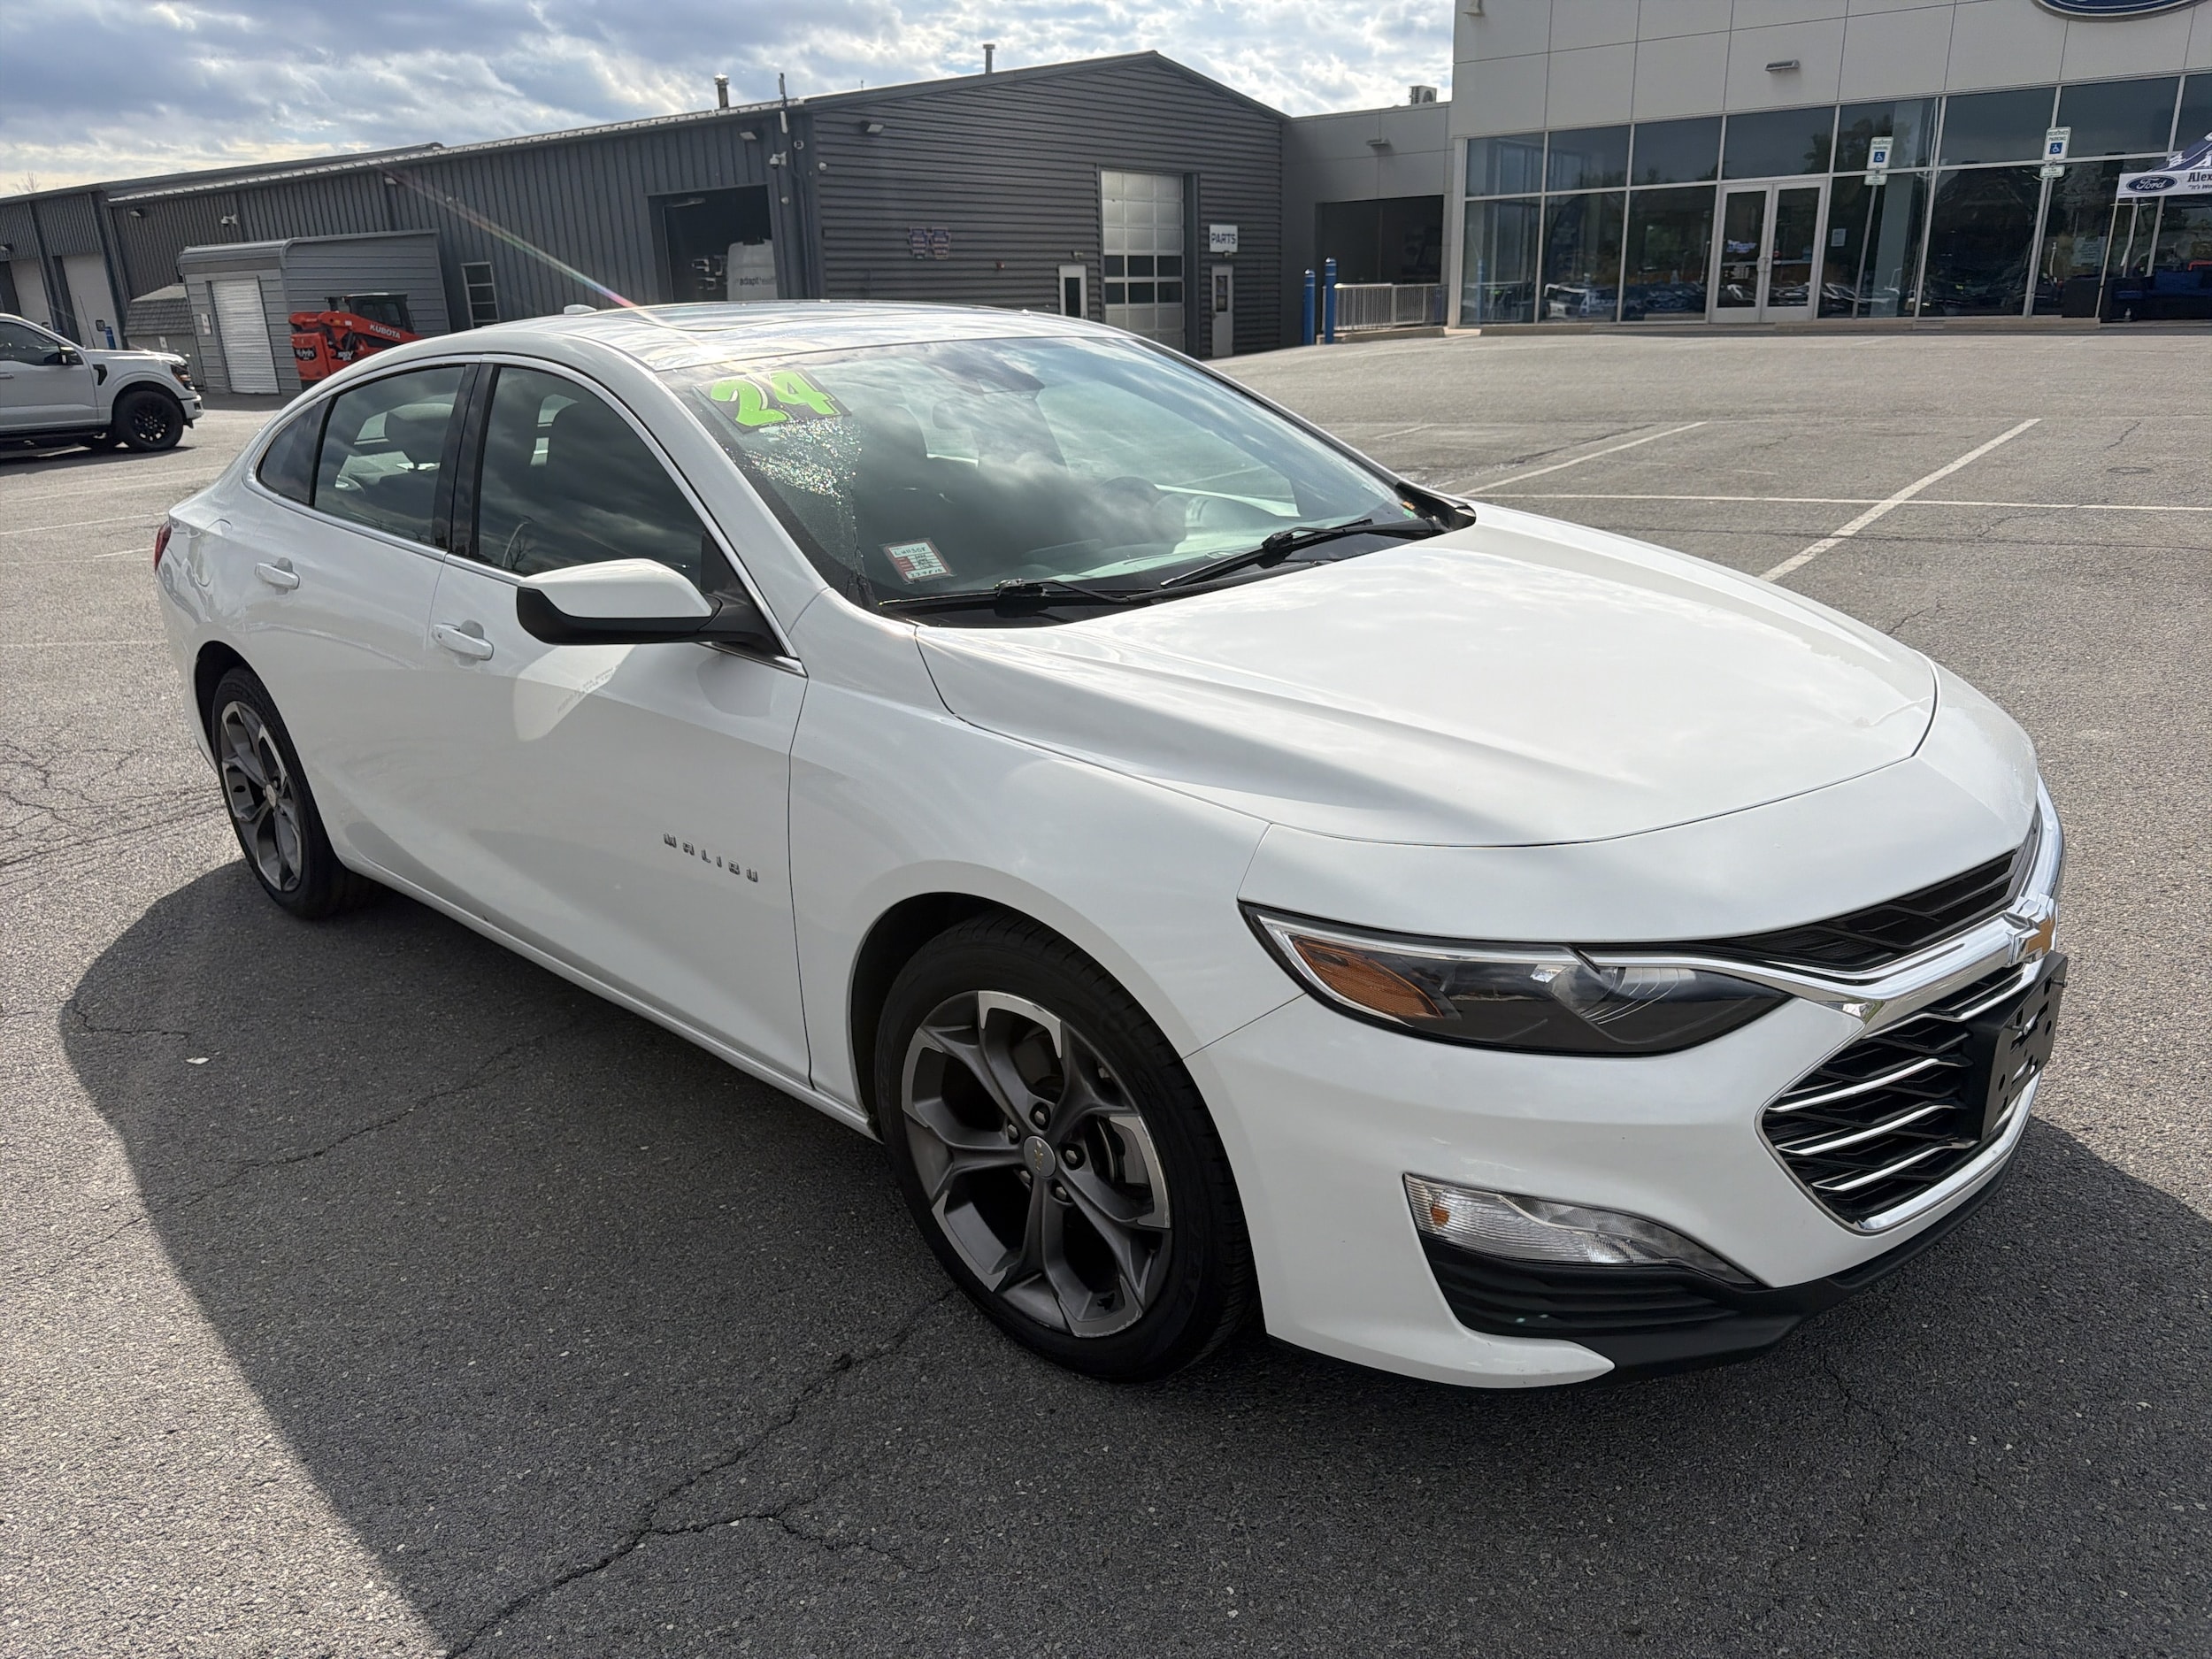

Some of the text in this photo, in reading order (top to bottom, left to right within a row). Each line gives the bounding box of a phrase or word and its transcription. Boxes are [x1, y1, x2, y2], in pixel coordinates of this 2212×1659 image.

[2135, 178, 2168, 190] Ford
[1211, 233, 1236, 244] PARTS
[369, 324, 401, 339] KUBOTA
[710, 371, 841, 426] 24
[663, 833, 758, 883] MALIBU
